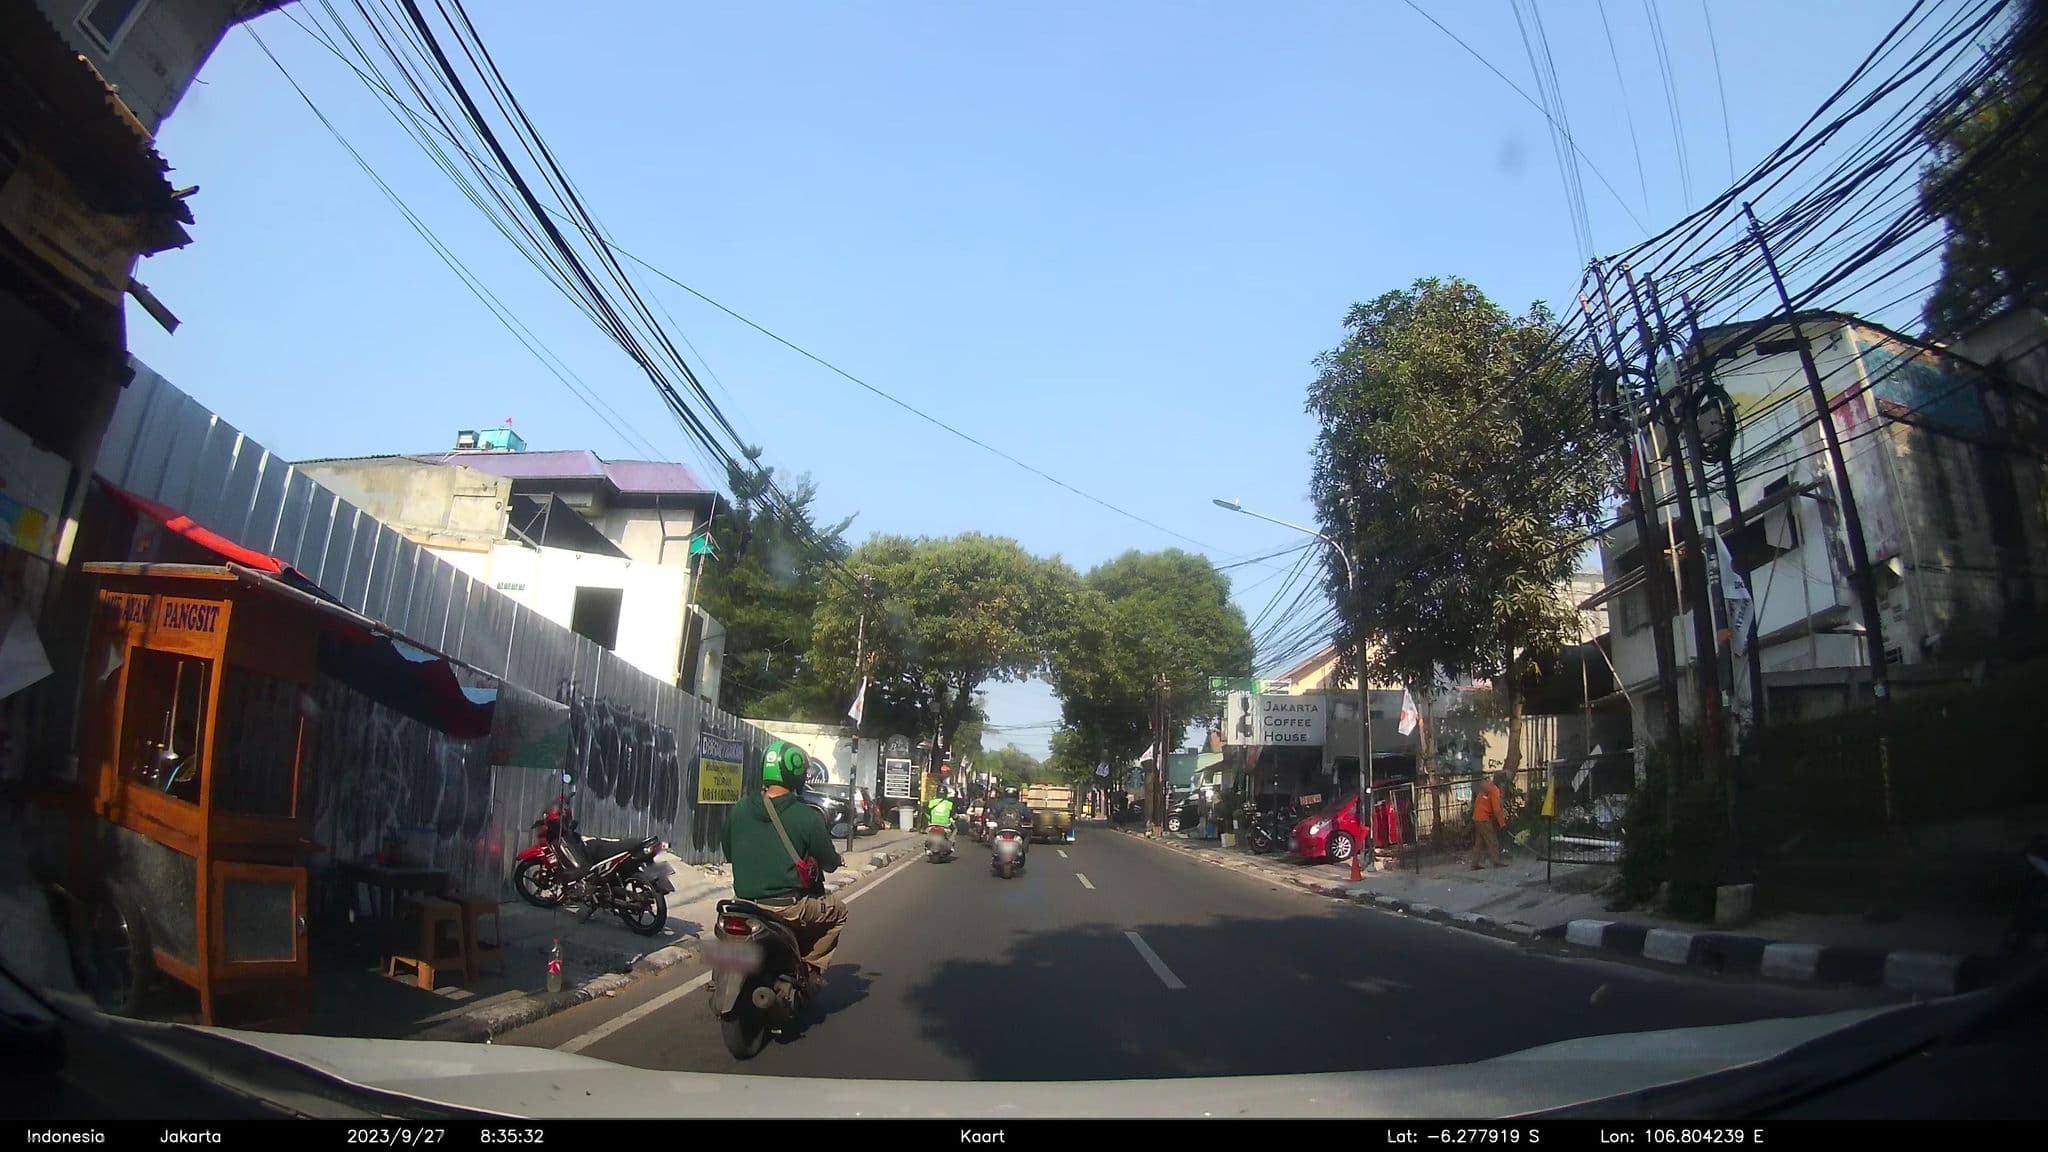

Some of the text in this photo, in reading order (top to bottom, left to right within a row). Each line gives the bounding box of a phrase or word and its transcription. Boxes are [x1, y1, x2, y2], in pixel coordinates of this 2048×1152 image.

[163, 602, 220, 633] PANGSIT
[1263, 701, 1319, 713] JAKARTA
[1263, 716, 1312, 727] COFFEE
[1264, 731, 1307, 742] HOUSE
